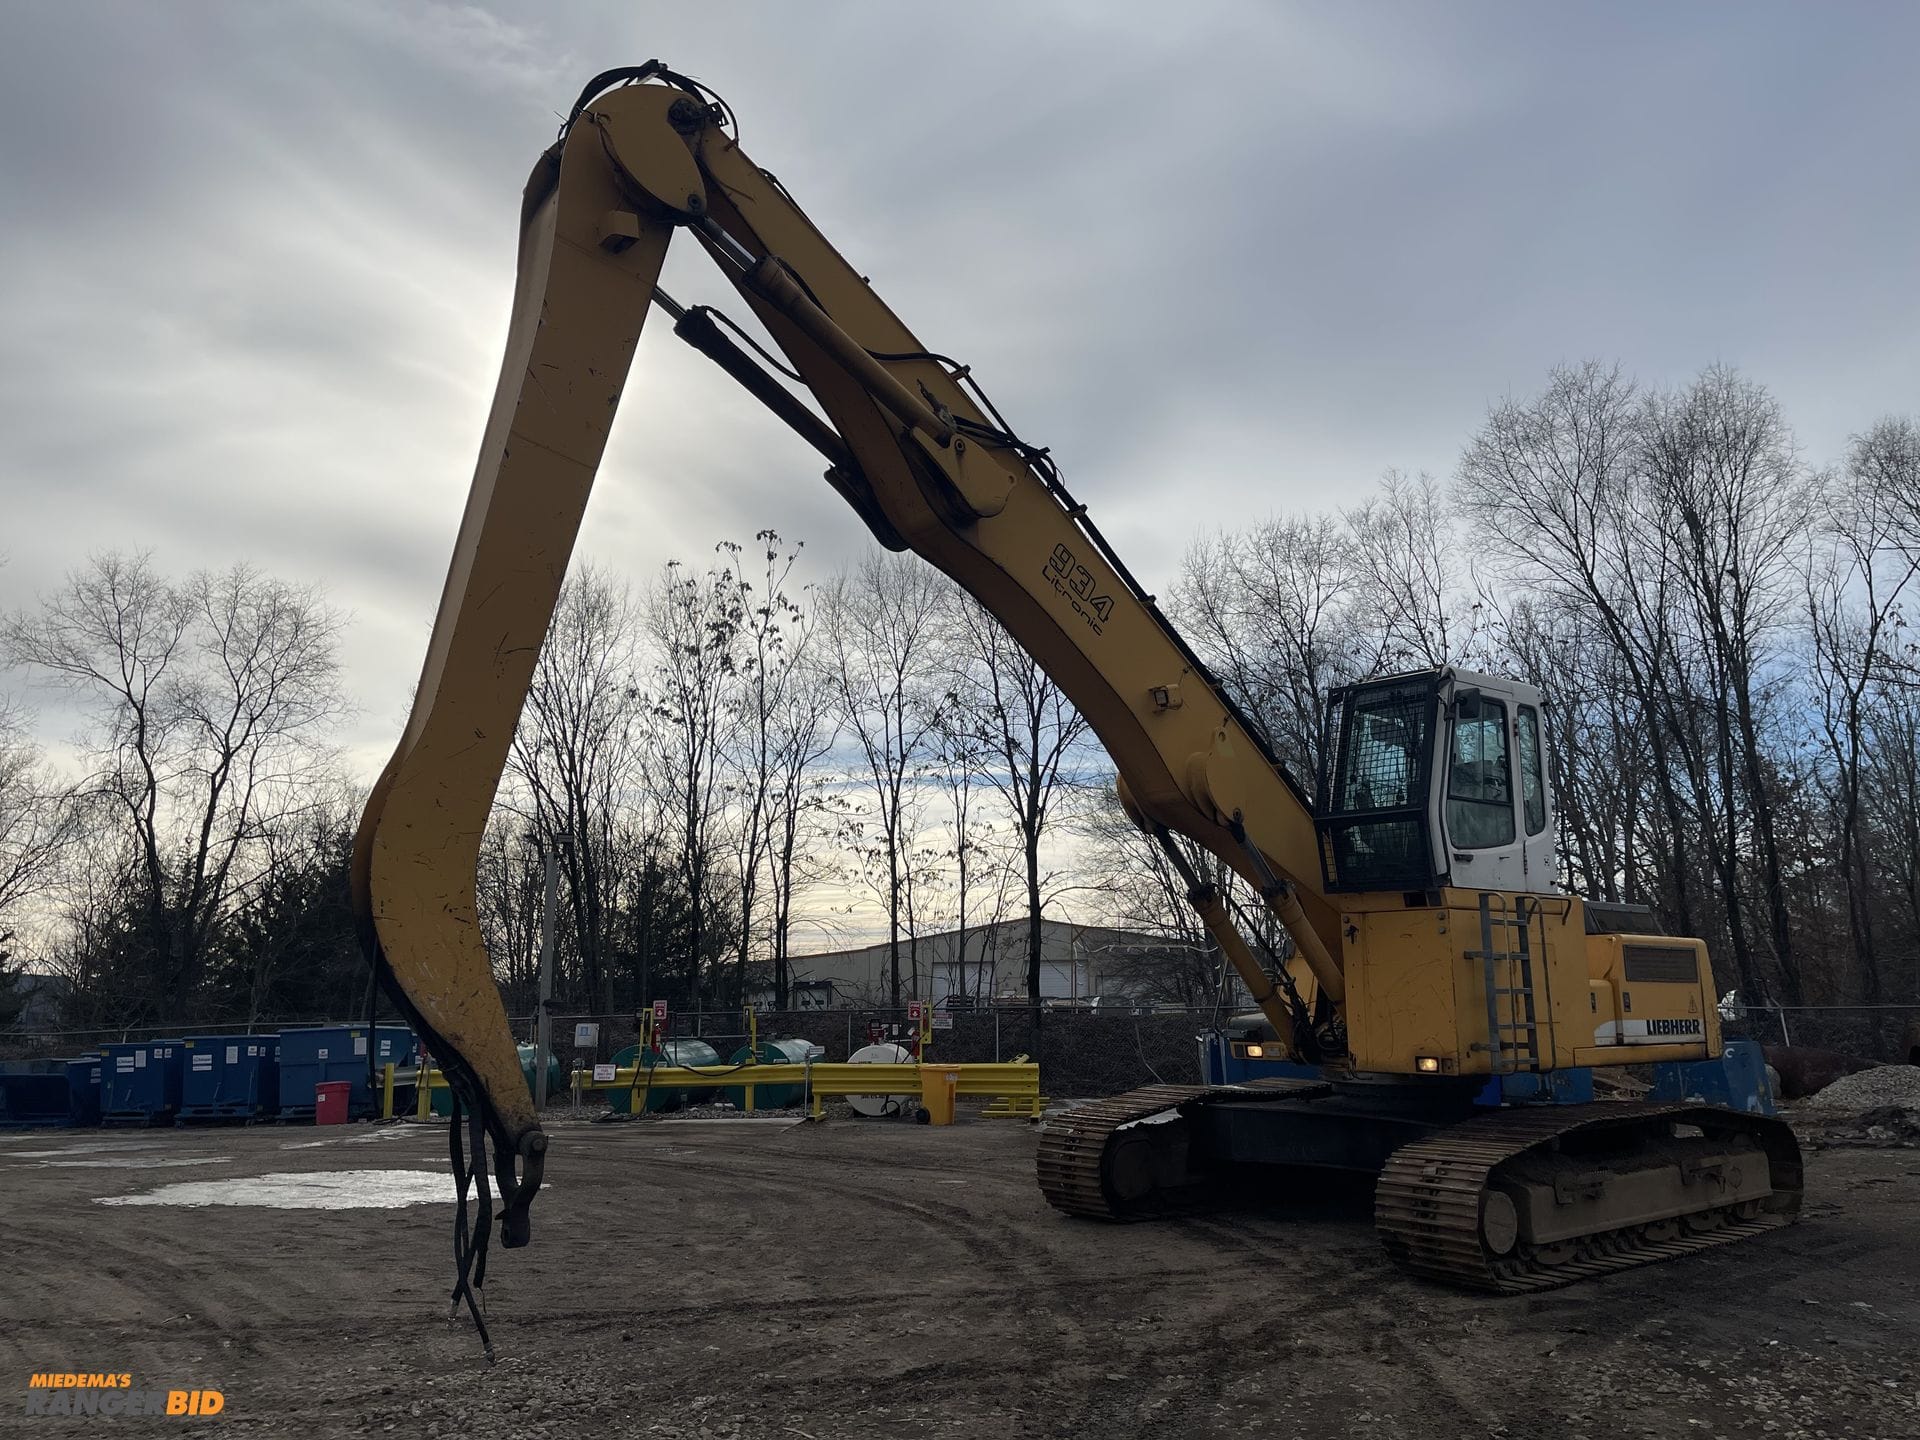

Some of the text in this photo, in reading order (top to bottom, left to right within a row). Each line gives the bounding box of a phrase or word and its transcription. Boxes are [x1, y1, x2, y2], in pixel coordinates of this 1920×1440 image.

[1042, 565, 1102, 636] Litronic
[1049, 543, 1114, 623] 934
[1646, 1019, 1700, 1036] LIEBHERR
